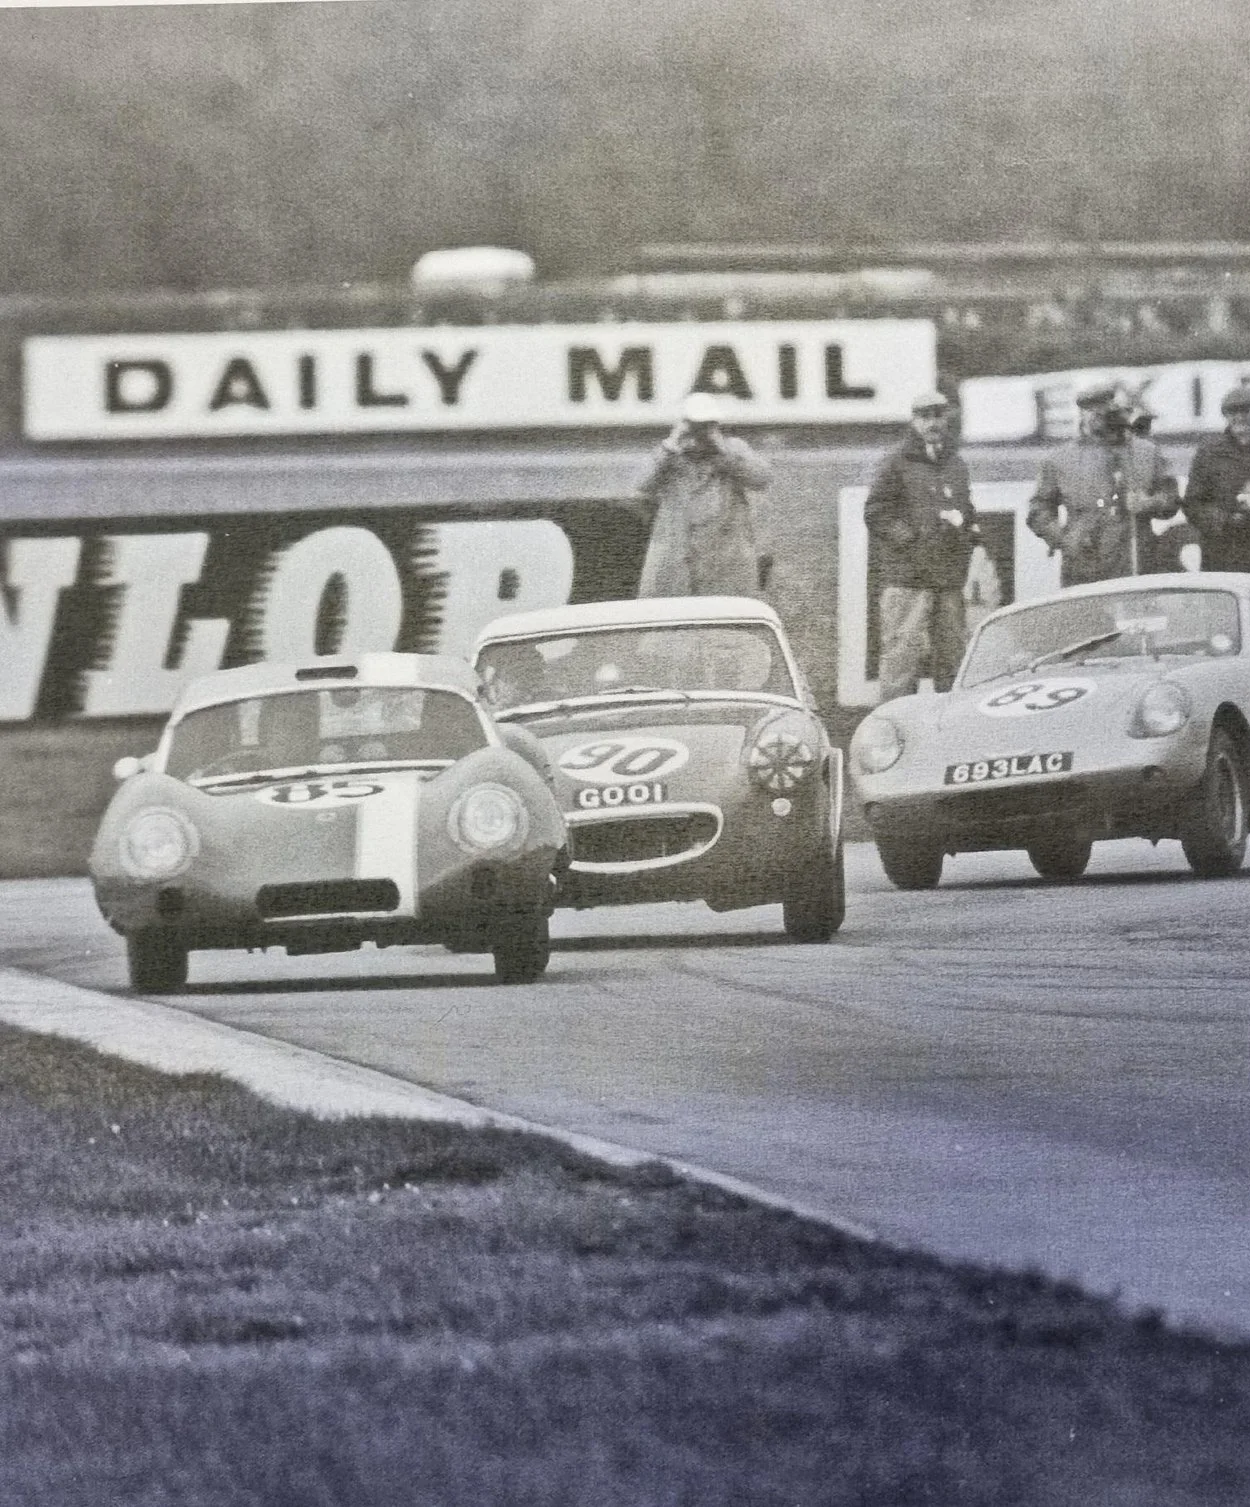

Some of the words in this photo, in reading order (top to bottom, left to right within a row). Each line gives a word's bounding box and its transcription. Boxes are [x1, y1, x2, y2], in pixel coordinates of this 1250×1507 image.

[104, 348, 479, 414] DAILY
[567, 343, 876, 402] MAIL
[986, 683, 1088, 710] 89
[559, 743, 679, 776] 90
[952, 752, 1063, 784] 693LAC
